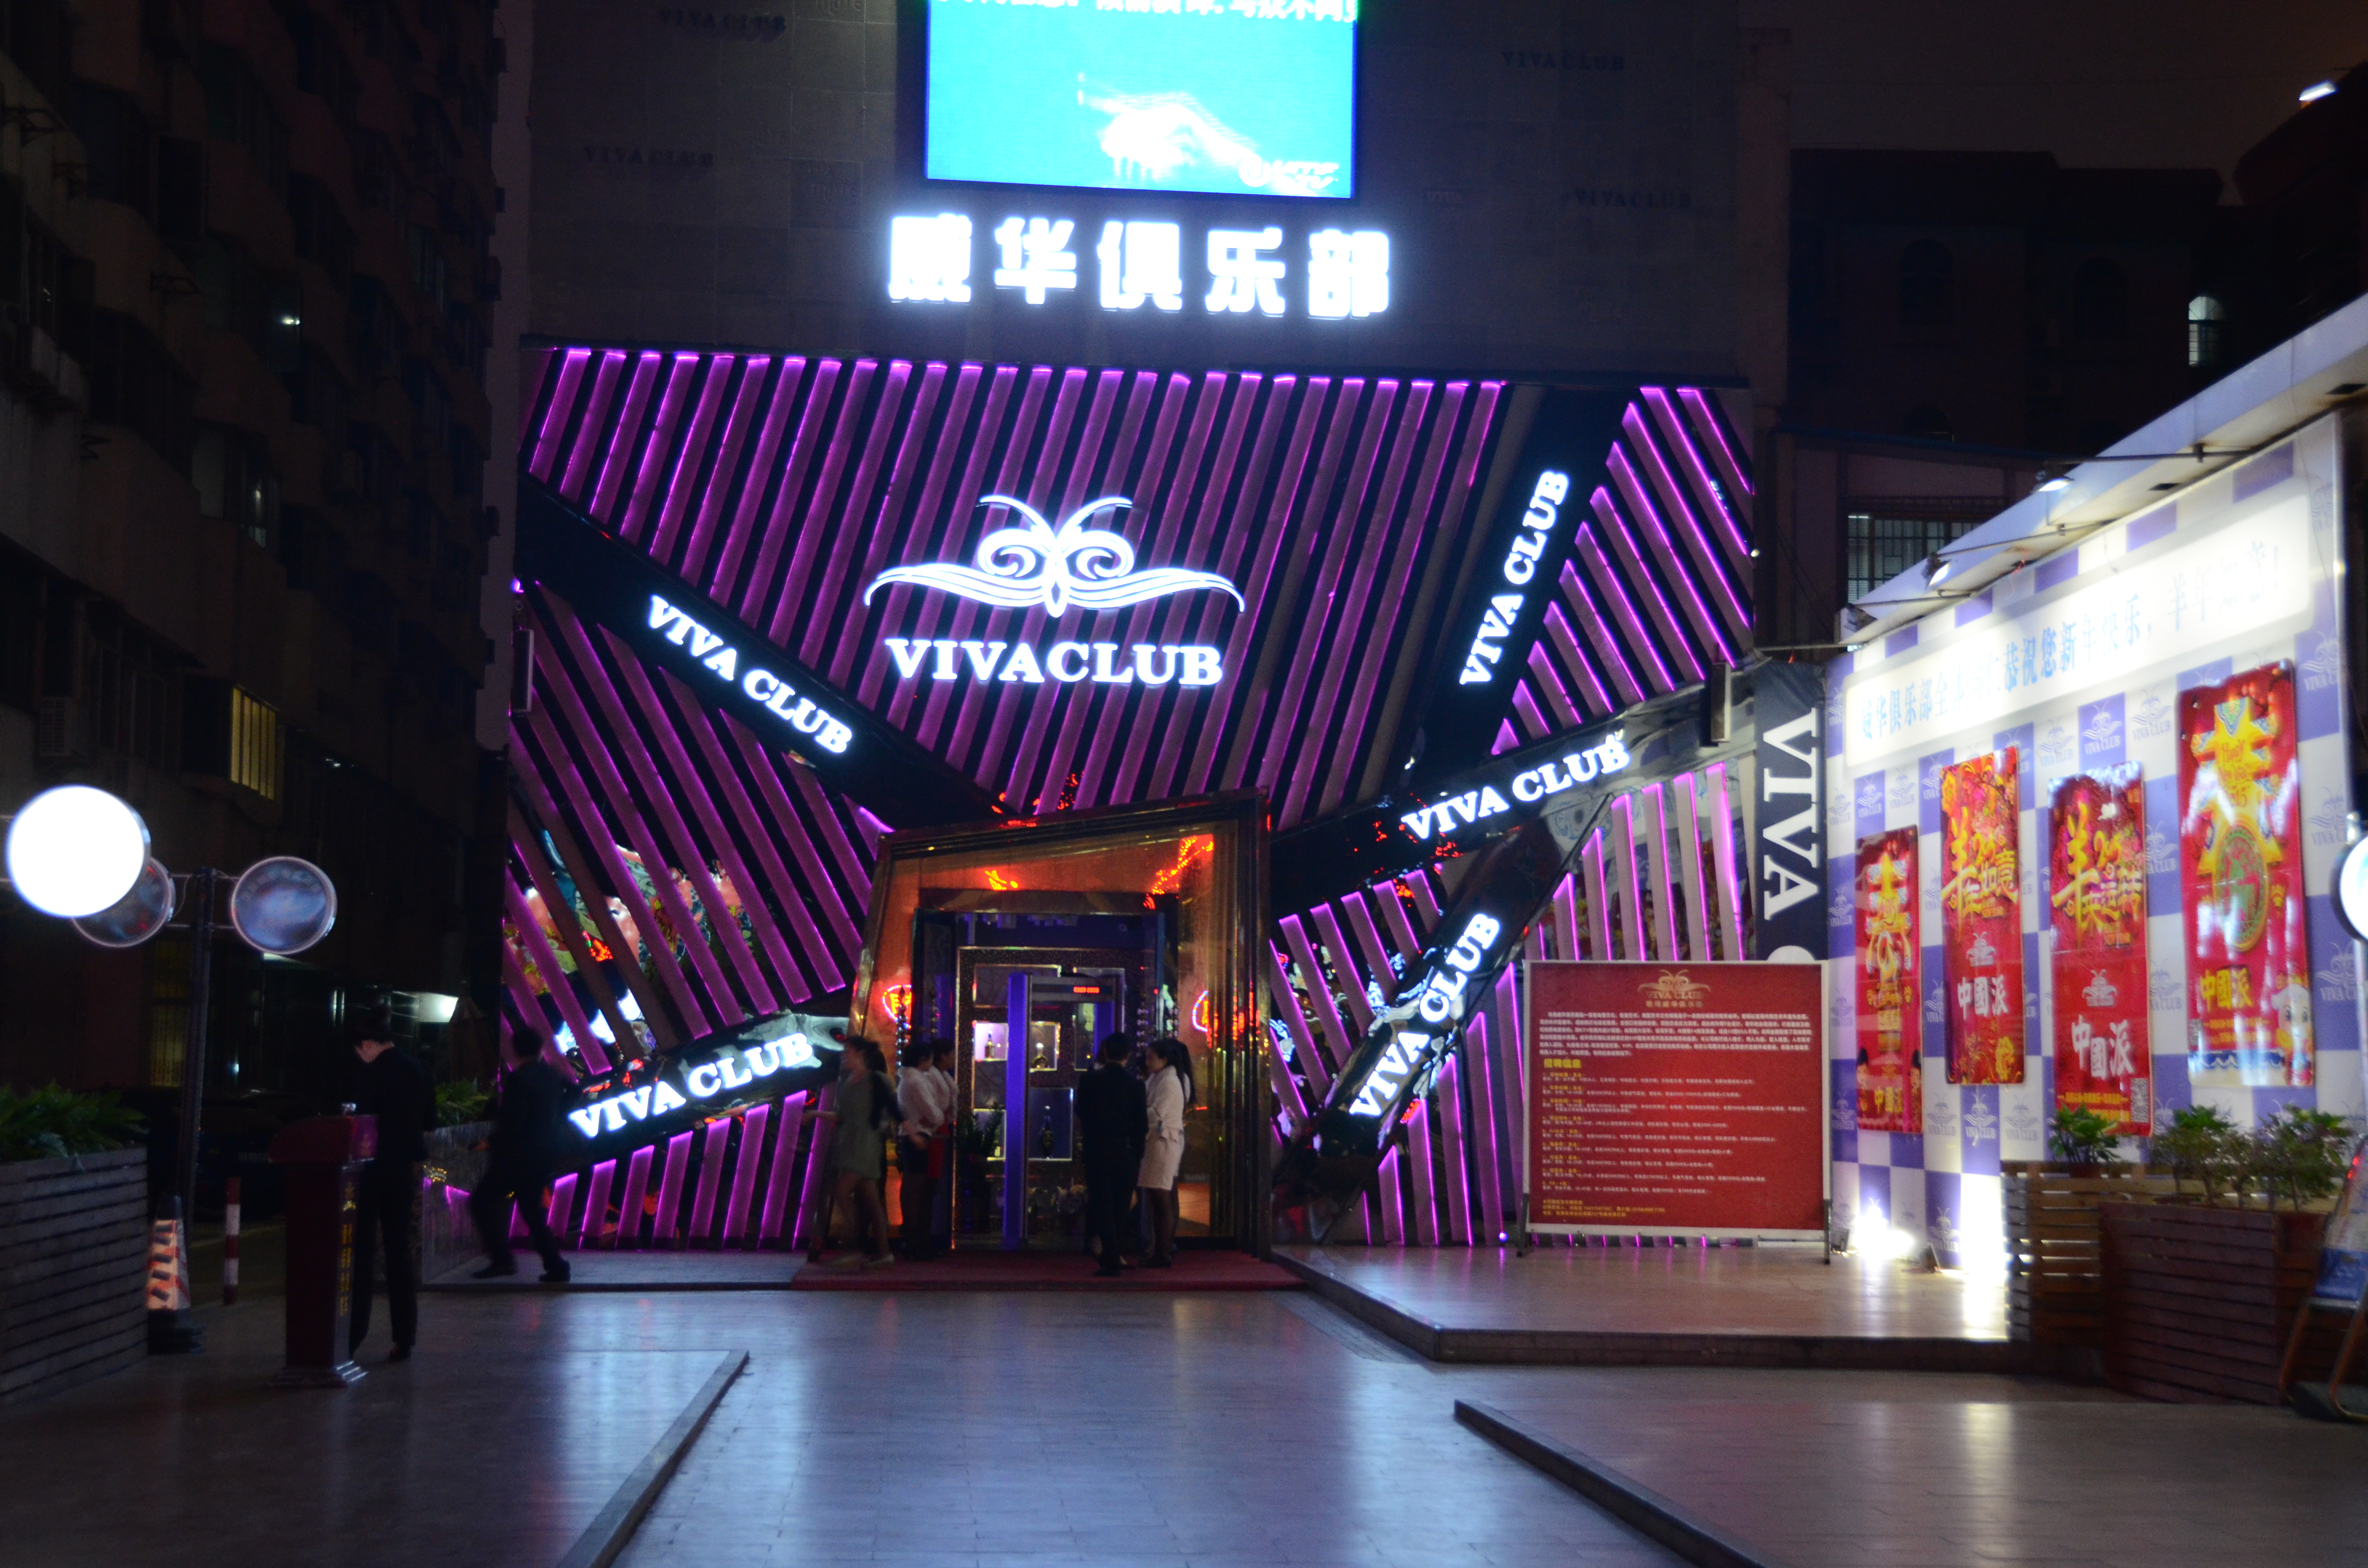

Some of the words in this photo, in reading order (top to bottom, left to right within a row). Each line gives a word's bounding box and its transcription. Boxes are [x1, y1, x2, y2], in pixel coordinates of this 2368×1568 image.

[659, 10, 715, 29] VIVA
[722, 13, 786, 34] CLUB
[1501, 51, 1556, 68] VIVA
[1561, 53, 1624, 71] CLUB
[584, 146, 642, 164] VIVA
[649, 150, 713, 167] CLUB
[1574, 190, 1626, 207] VIVA
[1630, 192, 1691, 208] CLUB
[888, 213, 1390, 318] 威华俱乐部
[1459, 595, 1523, 685] VIVA
[1505, 469, 1569, 584] CLUB
[648, 595, 737, 681] VIVA
[743, 669, 852, 753] CLUB
[2084, 741, 2100, 755] VIVA
[2101, 733, 2121, 750] CLUB
[2133, 729, 2149, 741] VIVA
[2149, 720, 2171, 738] CLUB
[1401, 786, 1510, 839] VIVA
[1512, 740, 1630, 801] CLUB
[1763, 708, 1819, 920] VIVA
[1349, 1032, 1430, 1116] VIVA
[1420, 914, 1500, 1022] CLUB
[1646, 991, 1672, 999] VIVA
[2072, 1014, 2134, 1081] 中國派
[568, 1081, 686, 1138] VIVA
[688, 1033, 813, 1097] CLUB
